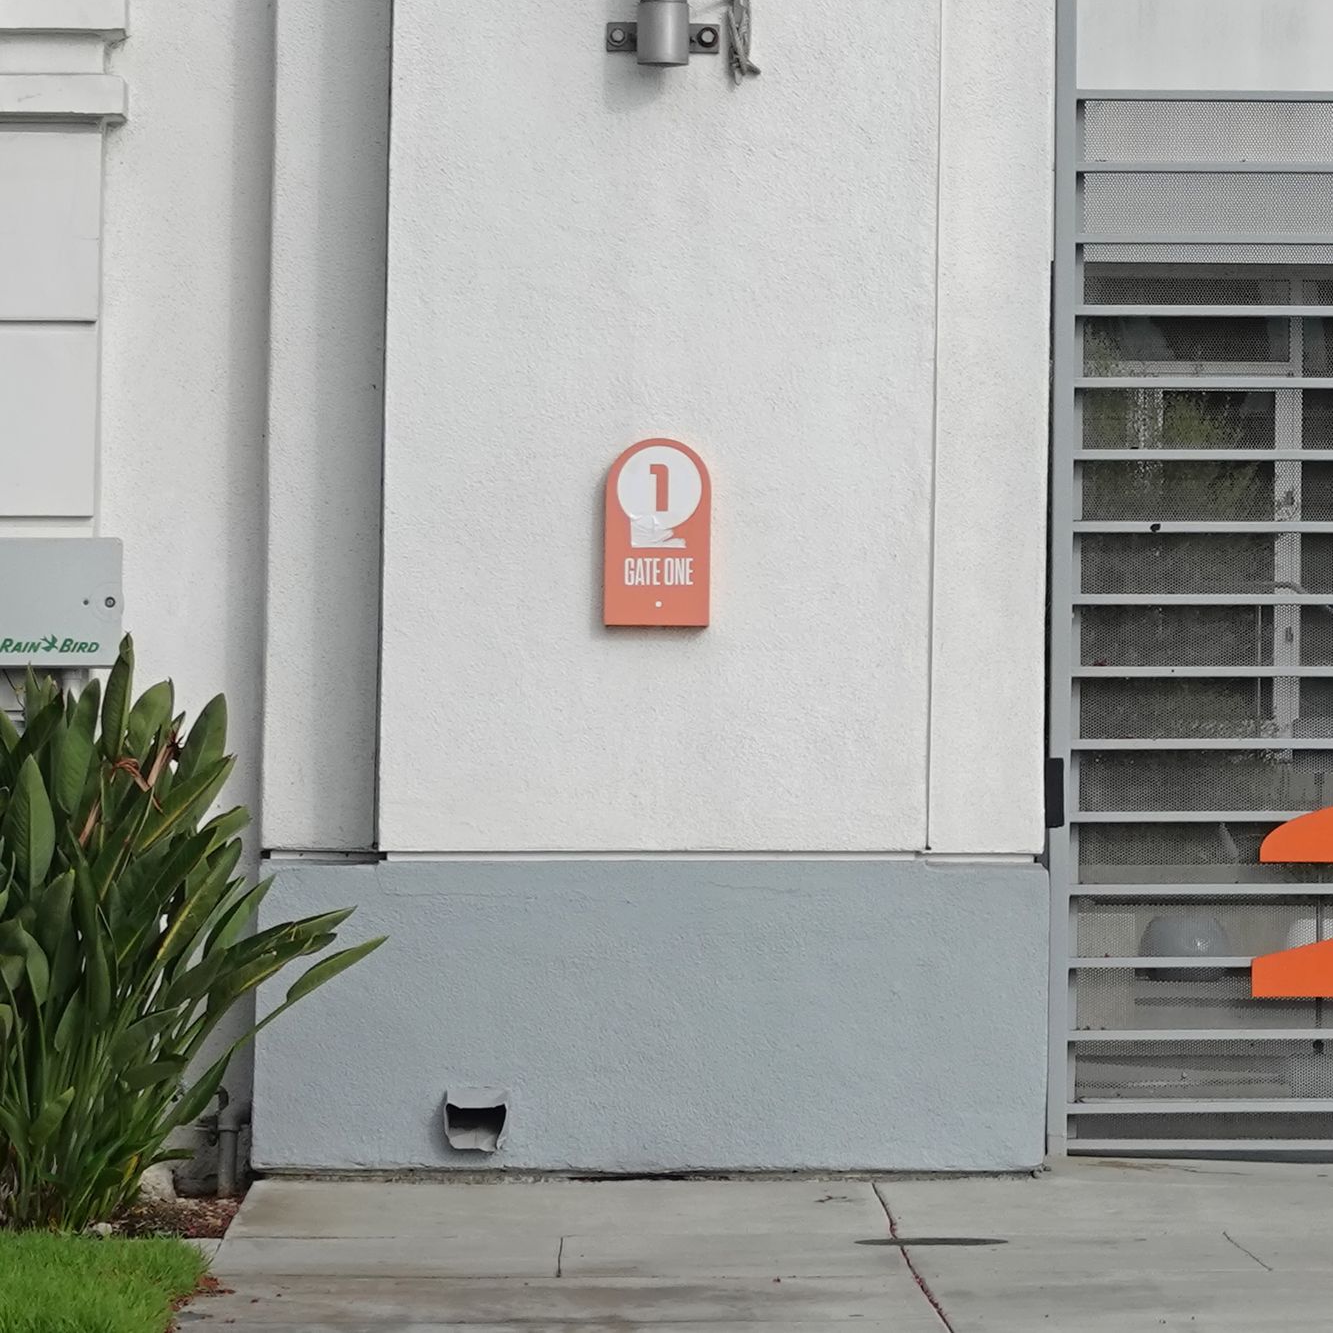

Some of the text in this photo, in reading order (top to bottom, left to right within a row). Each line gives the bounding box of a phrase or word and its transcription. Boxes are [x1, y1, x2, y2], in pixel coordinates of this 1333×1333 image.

[649, 463, 669, 512] 1
[624, 557, 693, 586] GATE ONE
[0, 638, 100, 653] RAIN BIRD
